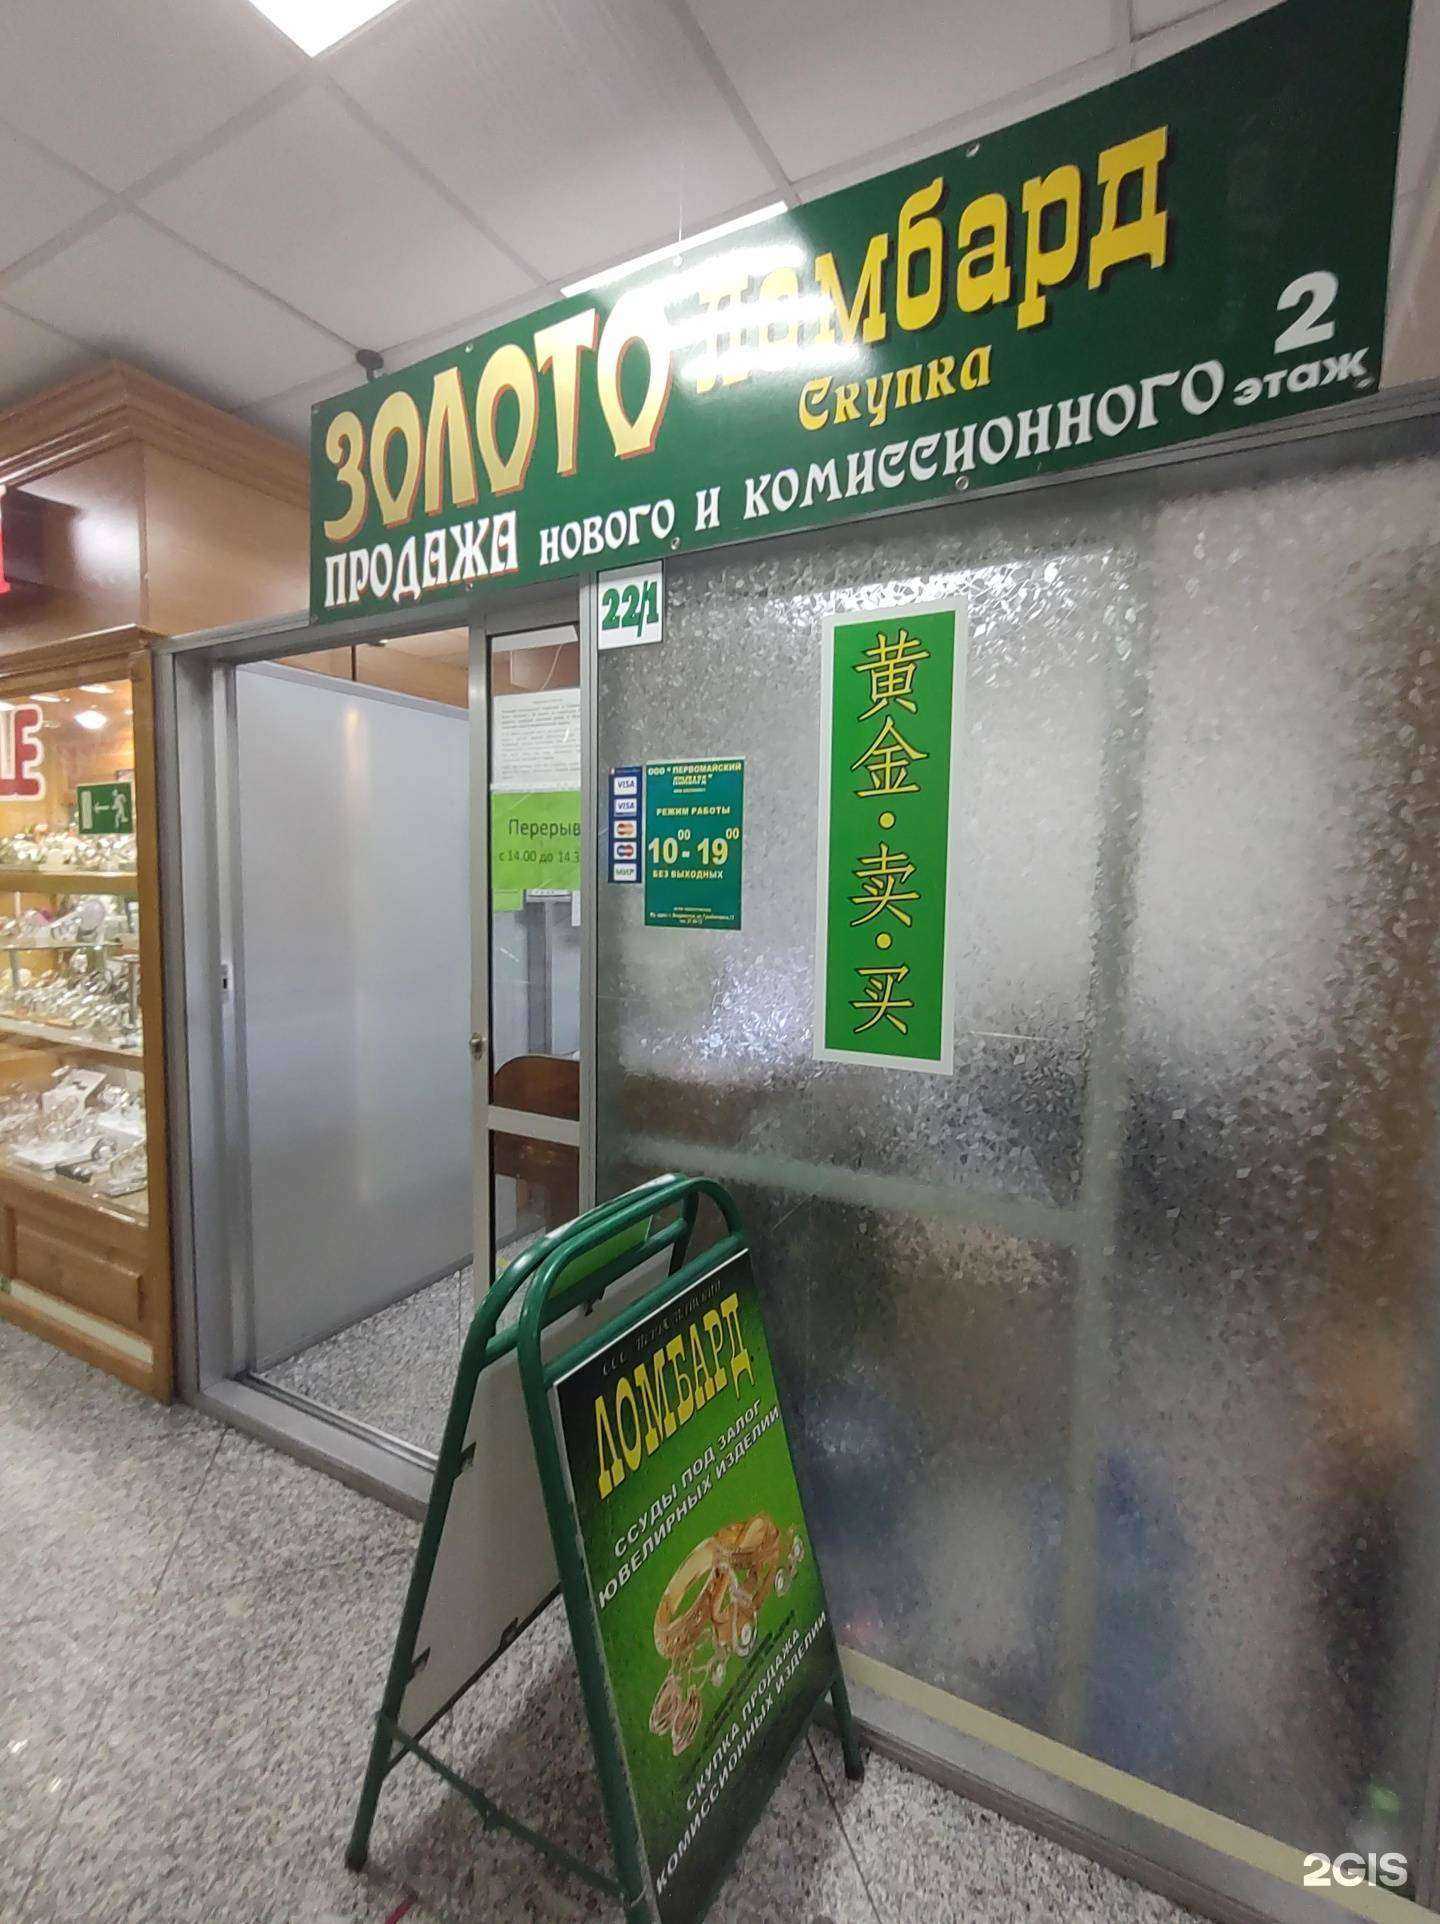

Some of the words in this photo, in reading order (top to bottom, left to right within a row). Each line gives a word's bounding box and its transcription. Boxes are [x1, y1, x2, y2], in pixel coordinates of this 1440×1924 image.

[1273, 271, 1338, 354] 2
[324, 289, 673, 543] ЗОЛОТО
[797, 345, 992, 430] Скупка
[1232, 346, 1369, 406] этаж
[324, 510, 519, 607] ПРОДАЖА
[602, 581, 659, 637] 22/1
[617, 780, 635, 788] VISA
[617, 802, 635, 810] VISA
[656, 807, 689, 816] РЕЖИМ
[691, 806, 731, 815] РАБОТЫ
[508, 818, 581, 840] Перерыв
[653, 870, 669, 878] БЕЗ
[671, 869, 723, 879] ВЫХОДНЫХ
[595, 1292, 755, 1500] ЛОМБАРД
[614, 1484, 677, 1558] ССУДЫ
[681, 1446, 716, 1488] ПОД
[717, 1399, 761, 1451] ЗАЛОГ
[599, 1474, 713, 1609] ЮВЕЛИРНЫХ
[687, 1722, 741, 1811] СКУПКА
[742, 1629, 800, 1721] ПРОДАЖА
[656, 1695, 774, 1896] КОМИССИОННЫХ
